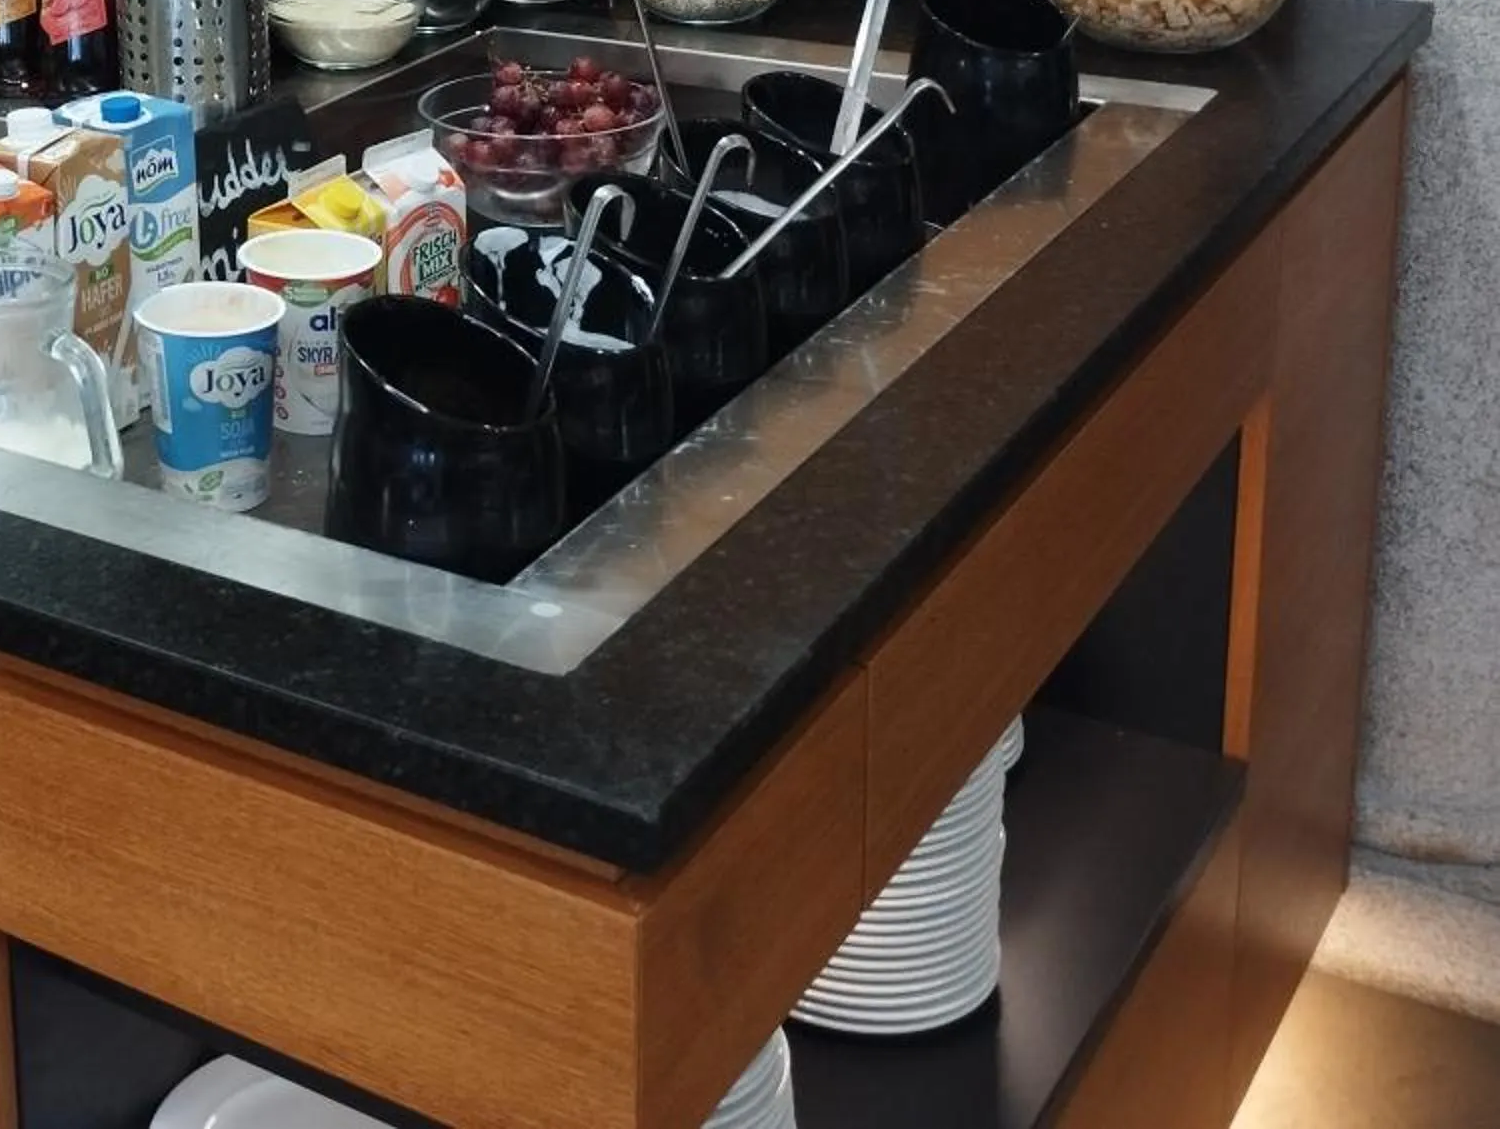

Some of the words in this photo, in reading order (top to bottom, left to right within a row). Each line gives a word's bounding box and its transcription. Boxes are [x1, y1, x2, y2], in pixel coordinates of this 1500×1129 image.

[67, 203, 127, 254] Joya
[412, 228, 457, 268] FRISCH
[418, 249, 454, 283] MIX
[81, 272, 124, 313] HAFER
[297, 346, 334, 364] SKYR
[203, 365, 265, 398] Joya
